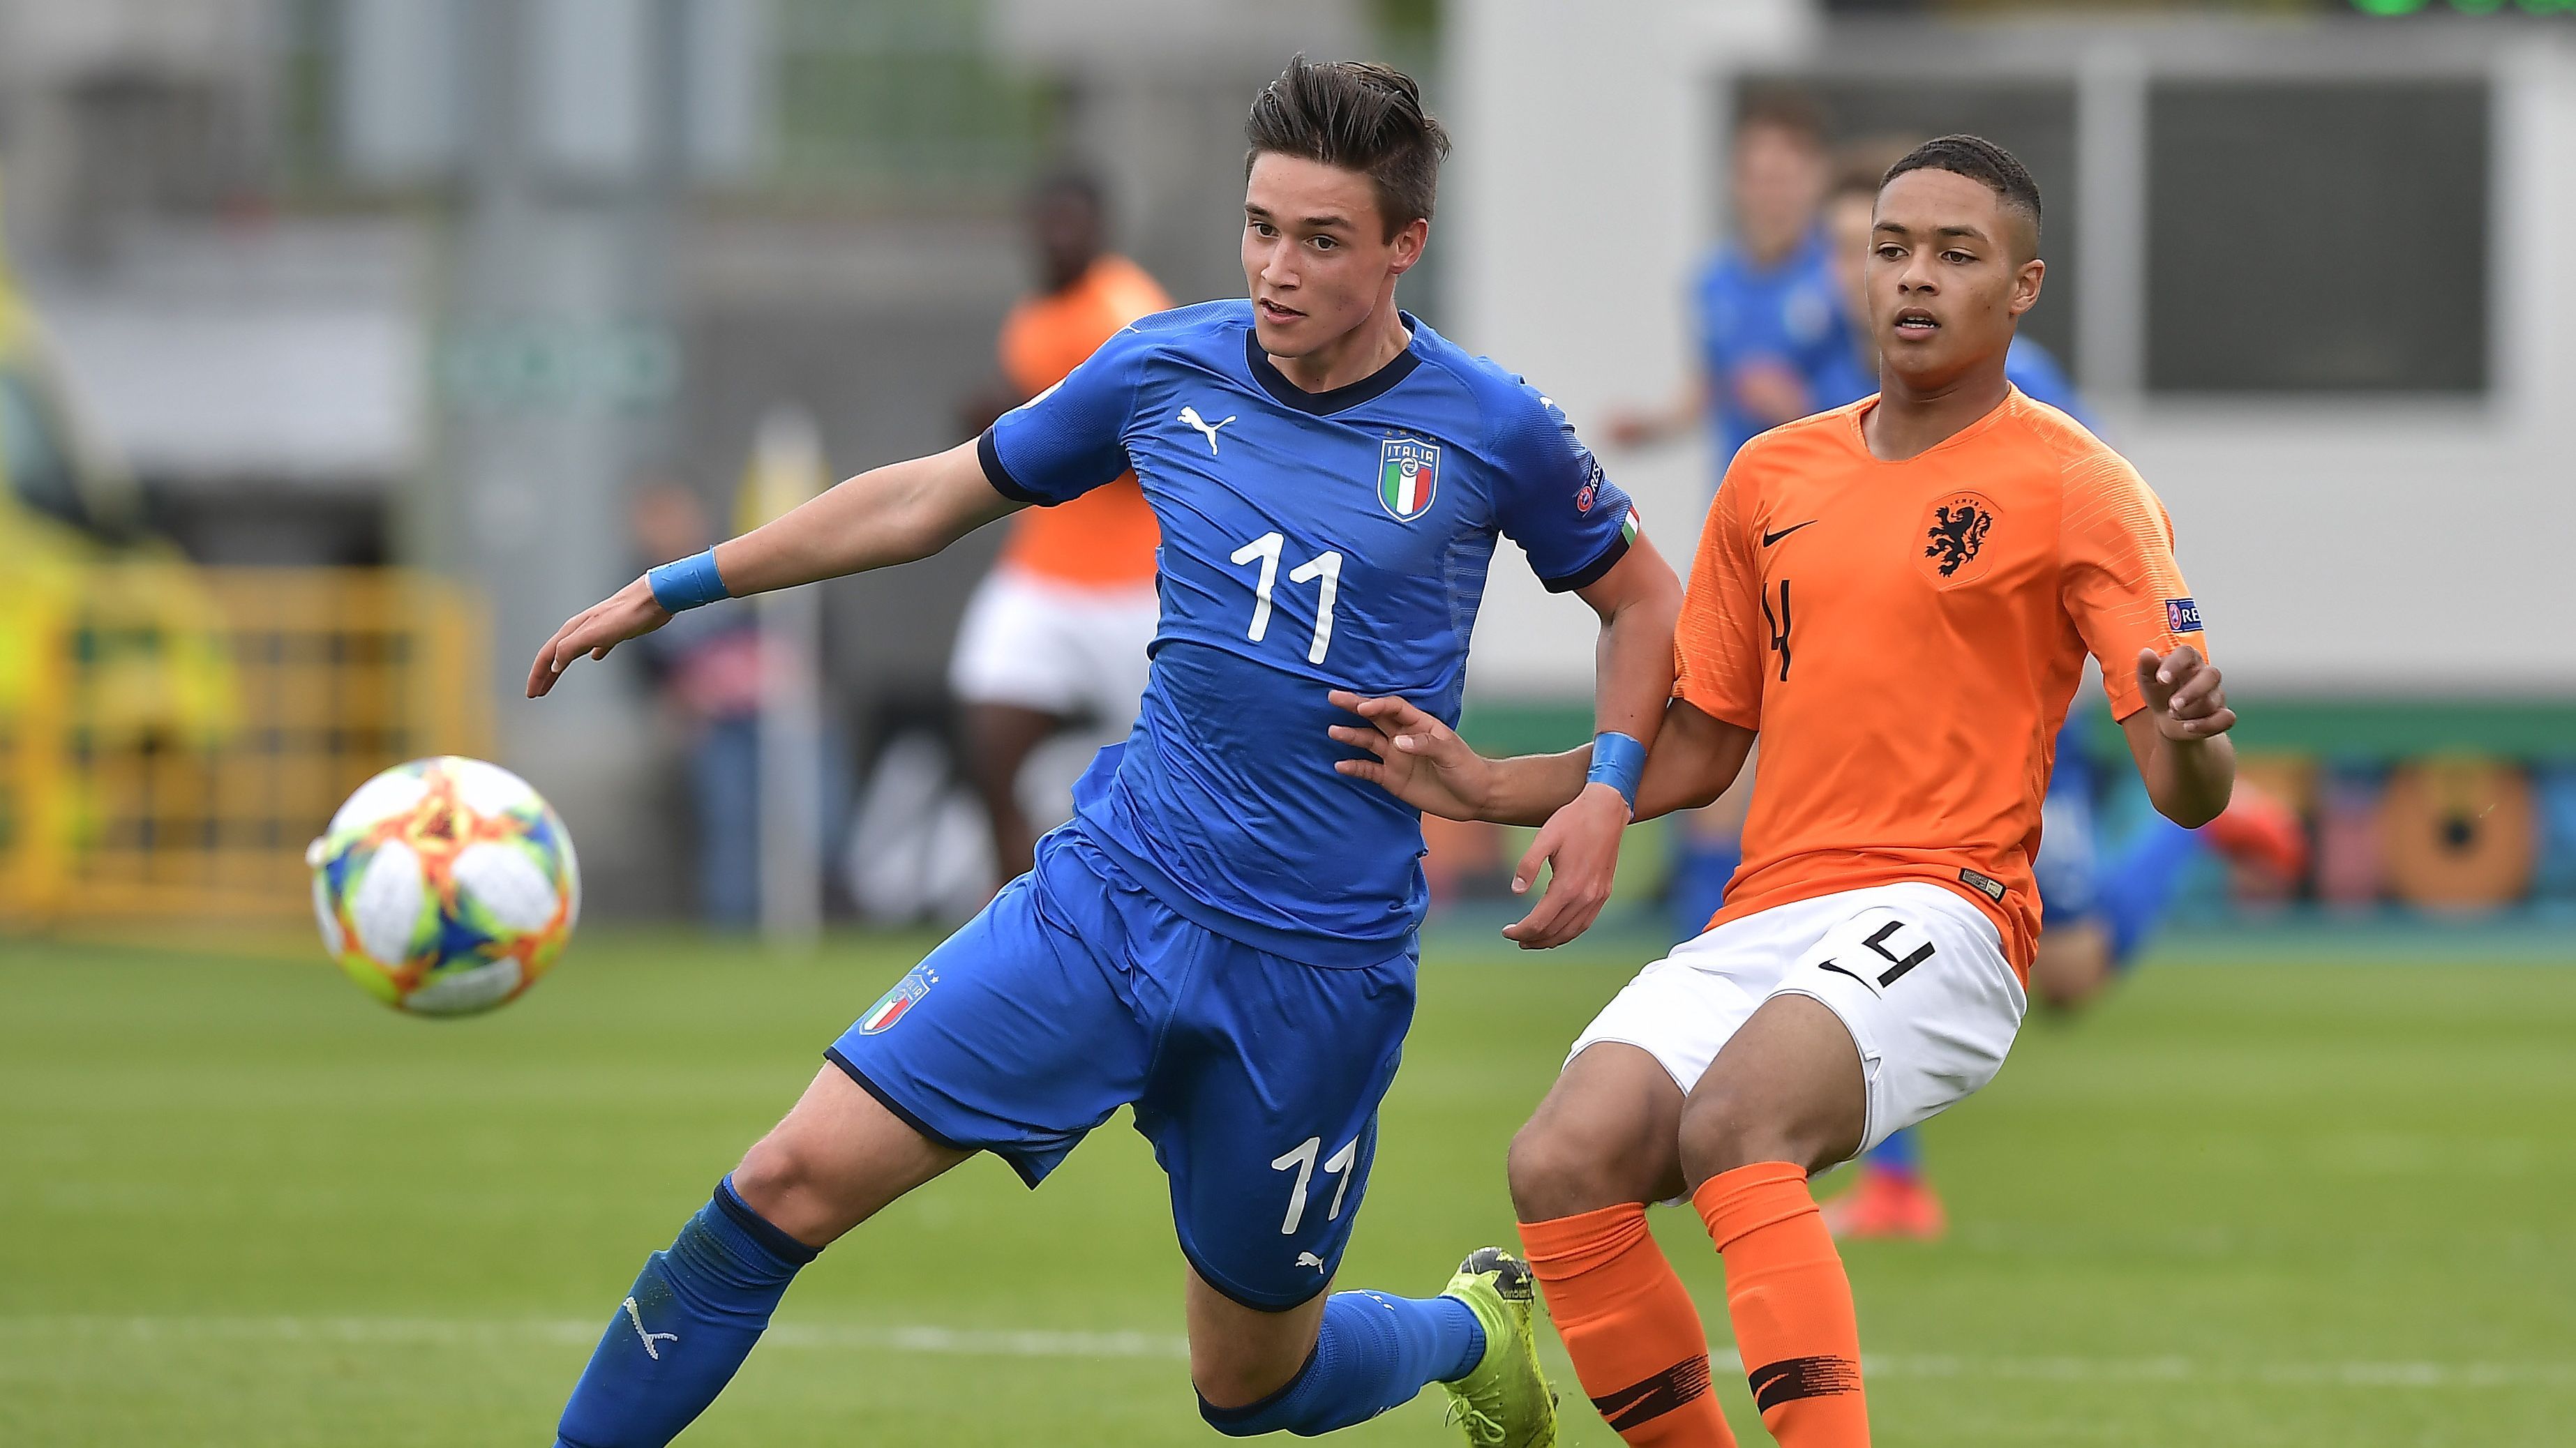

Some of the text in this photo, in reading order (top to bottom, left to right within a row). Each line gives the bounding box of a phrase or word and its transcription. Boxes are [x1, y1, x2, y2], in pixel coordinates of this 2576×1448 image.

[1388, 446, 1433, 462] ITALIA
[1231, 531, 1342, 665] 11
[1762, 580, 1791, 681] 4
[1862, 921, 1935, 988] 4
[1271, 1134, 1359, 1235] 11
